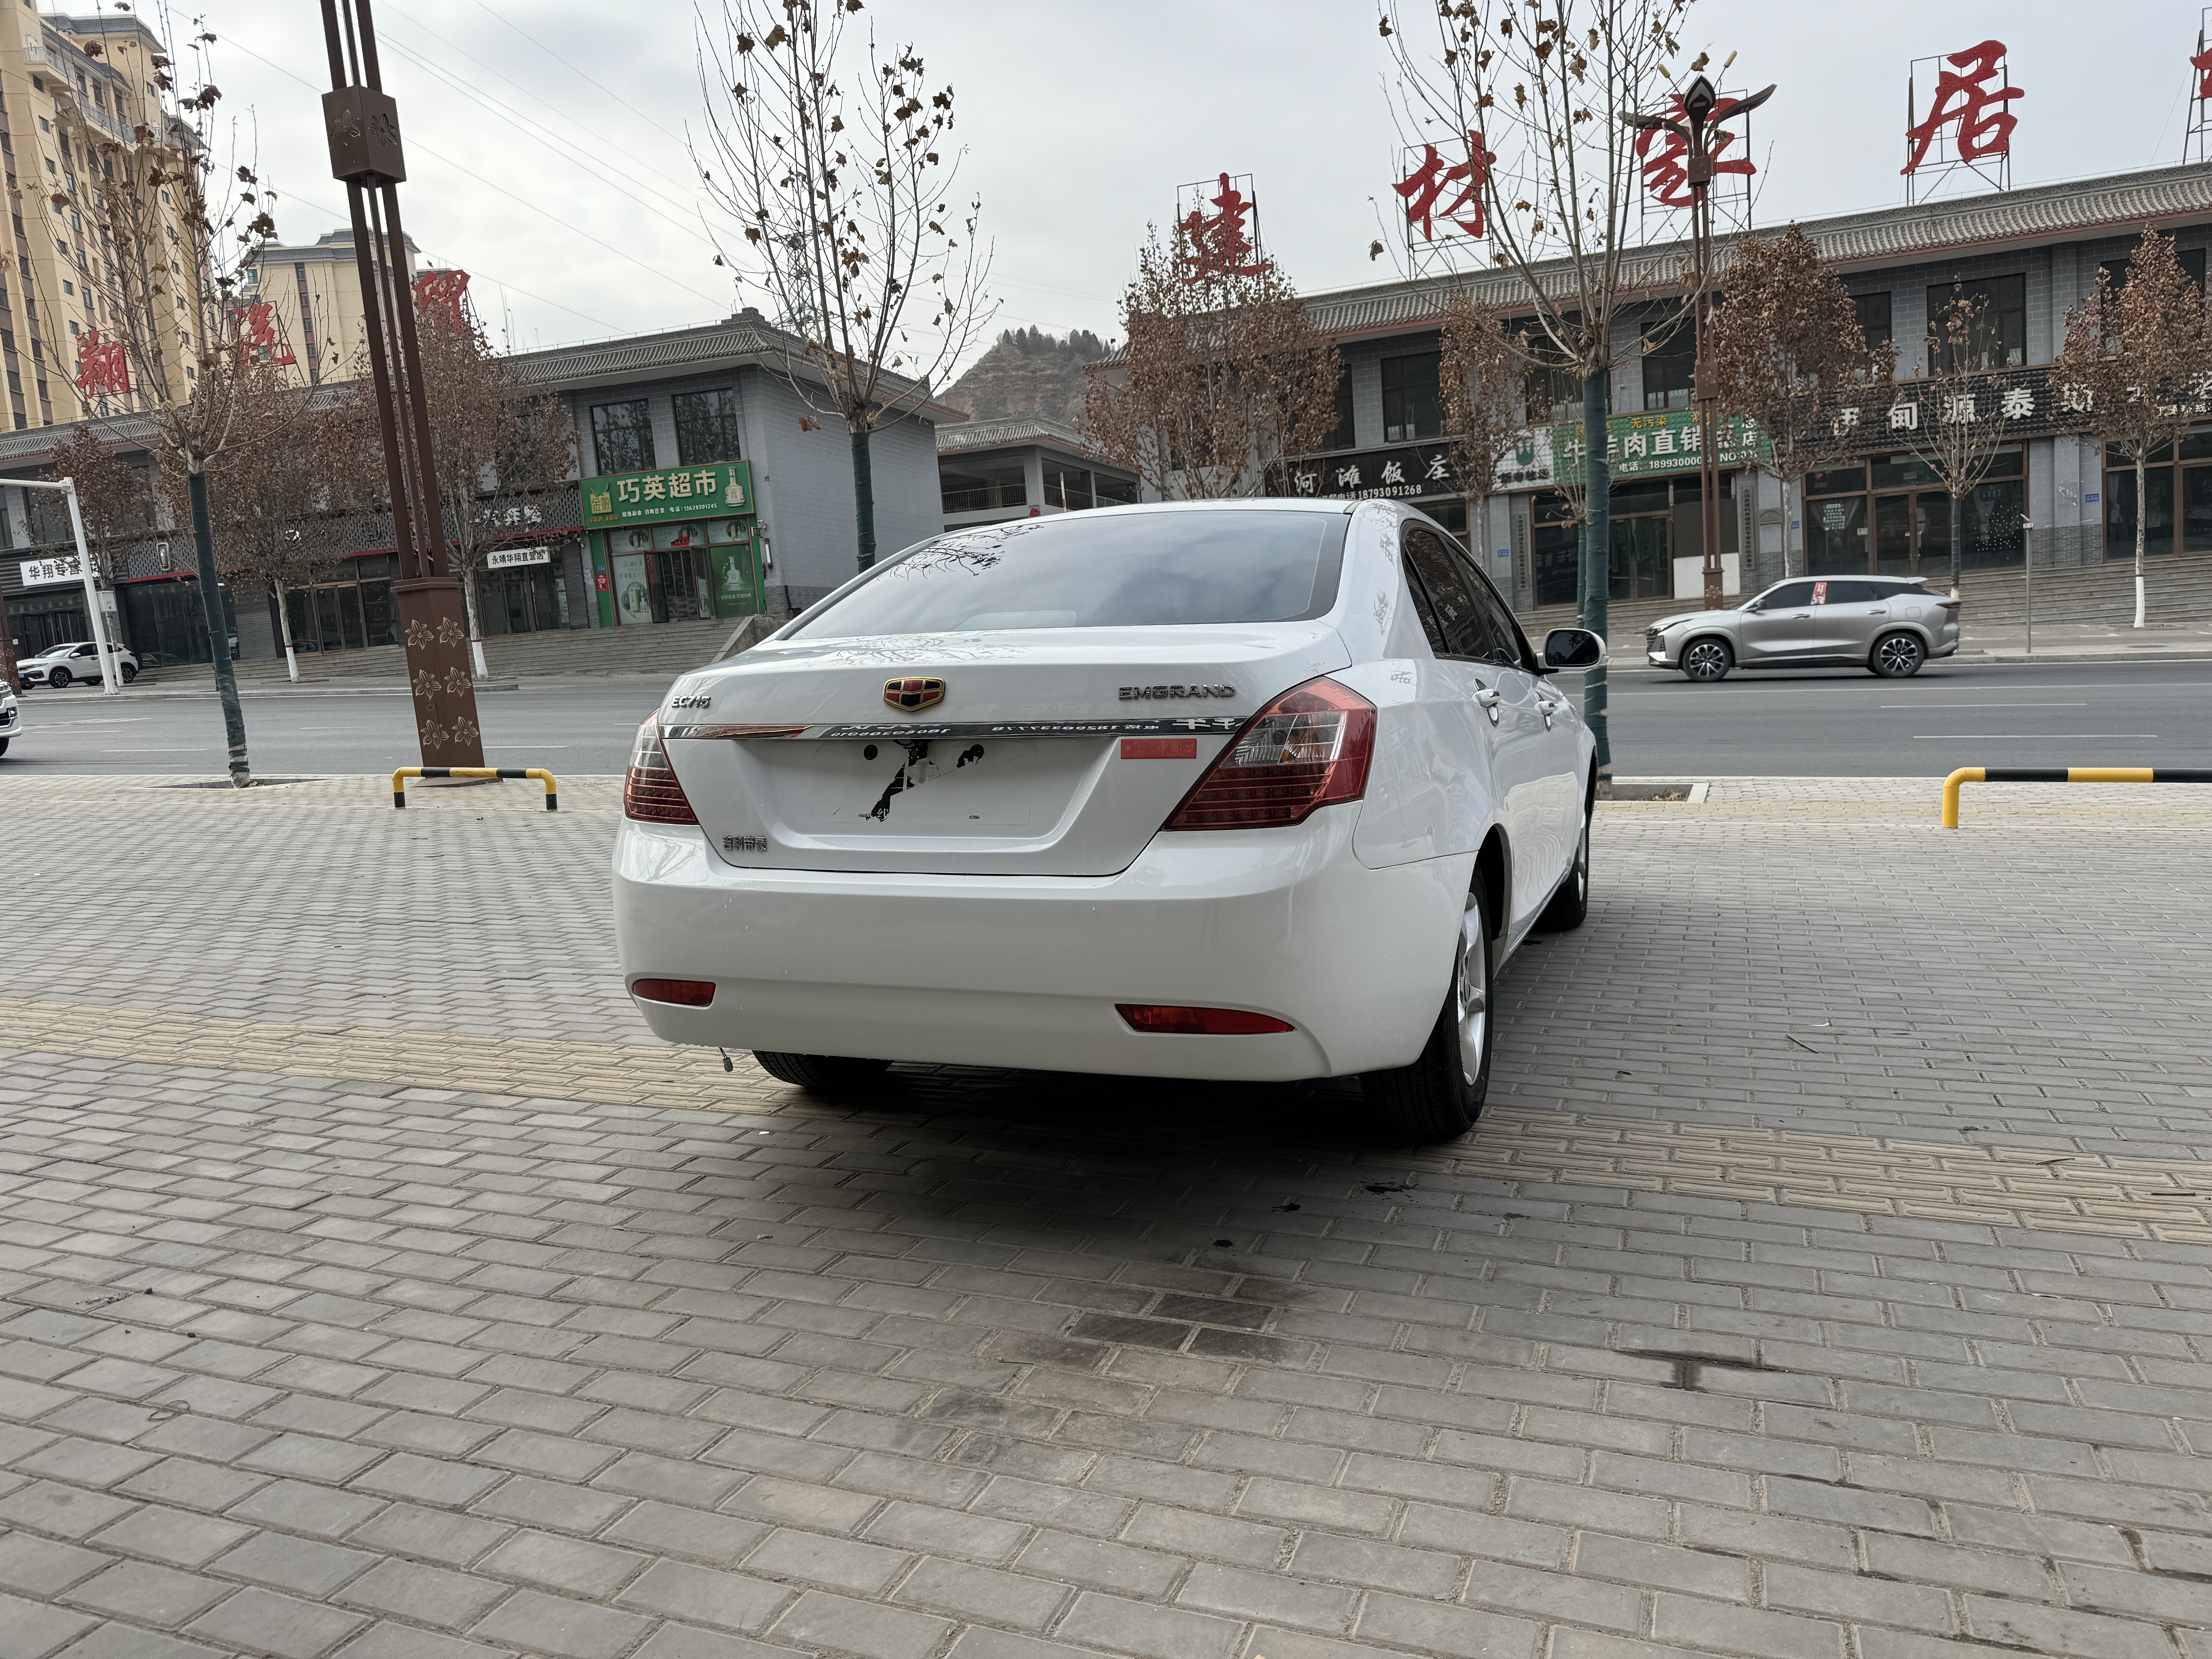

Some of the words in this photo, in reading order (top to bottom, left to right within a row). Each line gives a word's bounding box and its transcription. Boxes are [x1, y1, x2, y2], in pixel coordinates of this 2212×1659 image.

[1631, 415, 1667, 429] 无污染
[617, 470, 716, 503] 巧英超市
[492, 551, 544, 565] 永靖华翔直营店
[1119, 684, 1236, 699] EMGRAND
[672, 695, 711, 708] EC715
[1158, 741, 1195, 755] 中国心
[721, 835, 767, 851] 吉利帝豪
